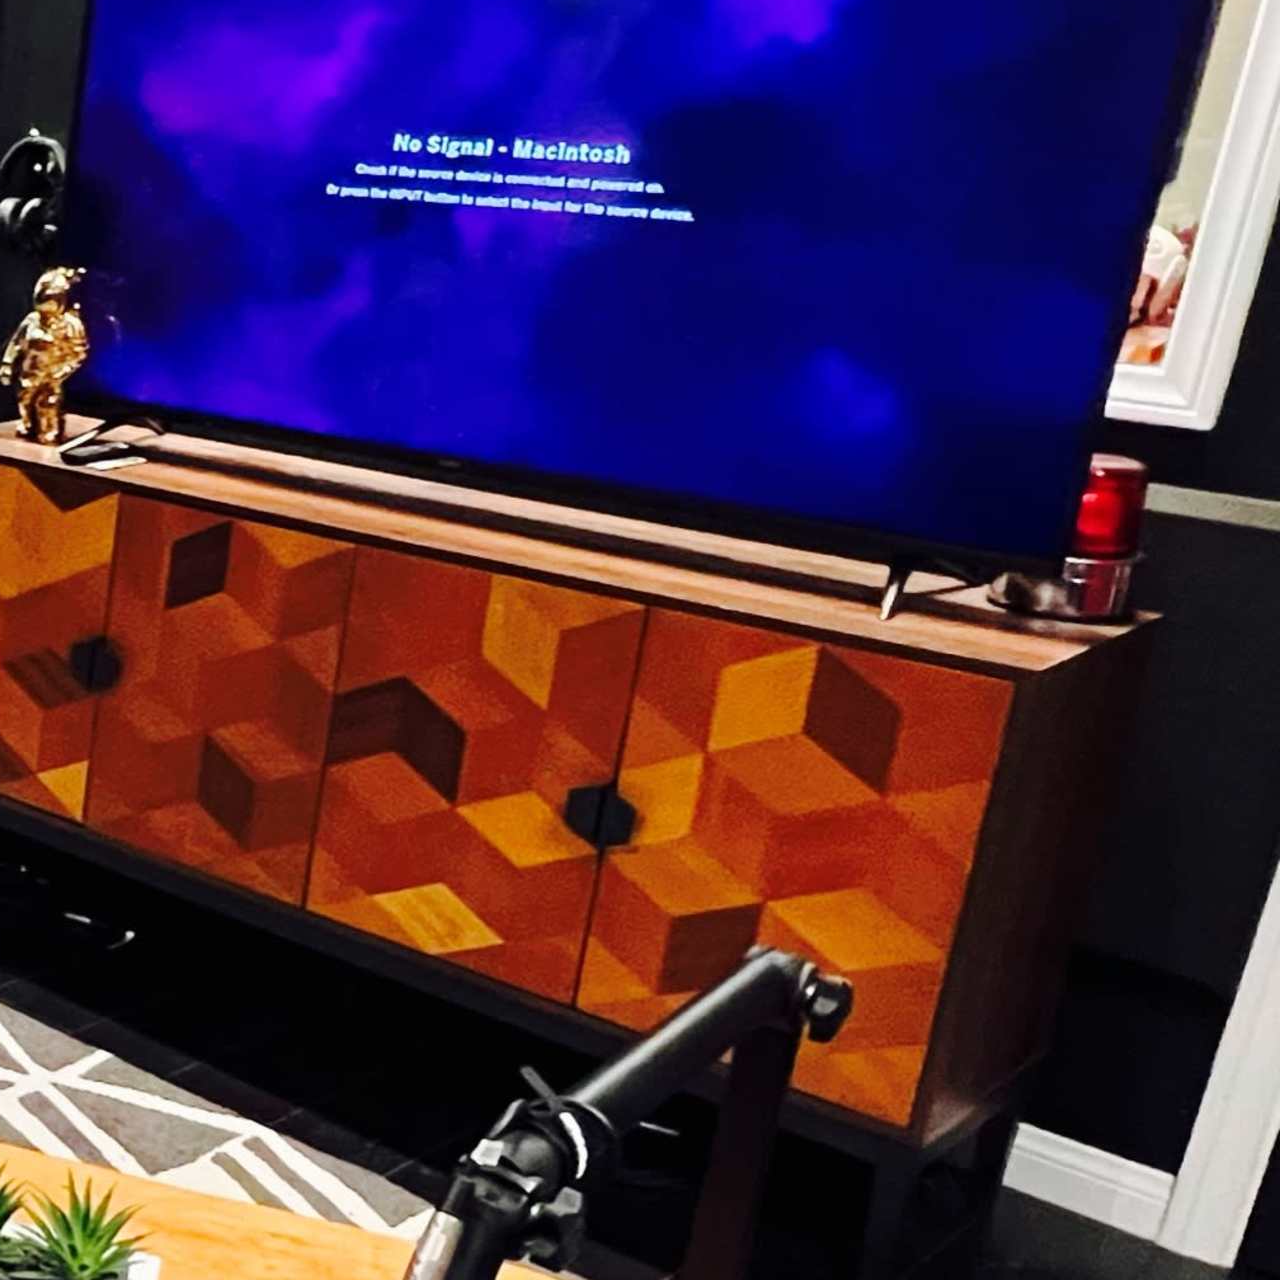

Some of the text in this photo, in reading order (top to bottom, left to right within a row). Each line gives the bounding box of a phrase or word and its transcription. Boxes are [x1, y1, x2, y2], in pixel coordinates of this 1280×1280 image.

[392, 133, 422, 153] No
[426, 134, 494, 159] Signal
[512, 138, 631, 164] Macintosh
